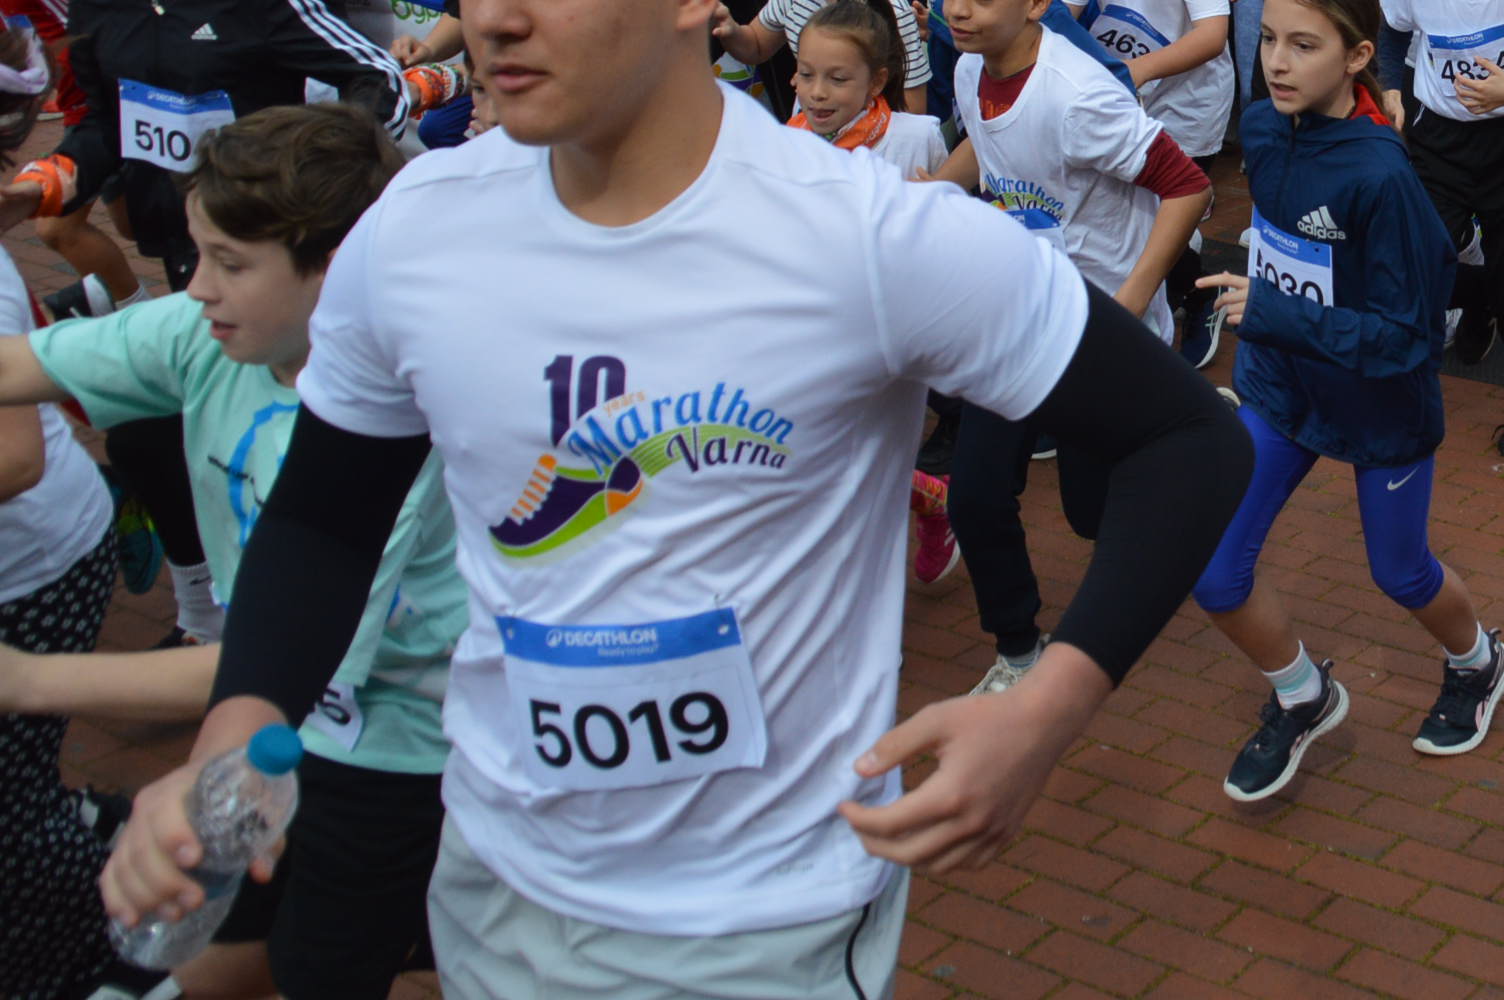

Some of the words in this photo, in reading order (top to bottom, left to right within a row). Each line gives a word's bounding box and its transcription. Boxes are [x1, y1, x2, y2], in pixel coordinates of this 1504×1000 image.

[1097, 28, 1151, 60] 463
[135, 119, 192, 162] 510
[1297, 220, 1346, 240] adidas
[543, 354, 627, 449] 10
[603, 391, 647, 417] years
[567, 381, 795, 476] Marathon
[666, 426, 789, 474] Varna
[564, 627, 658, 649] DECATHLON
[529, 691, 730, 771] 5019
